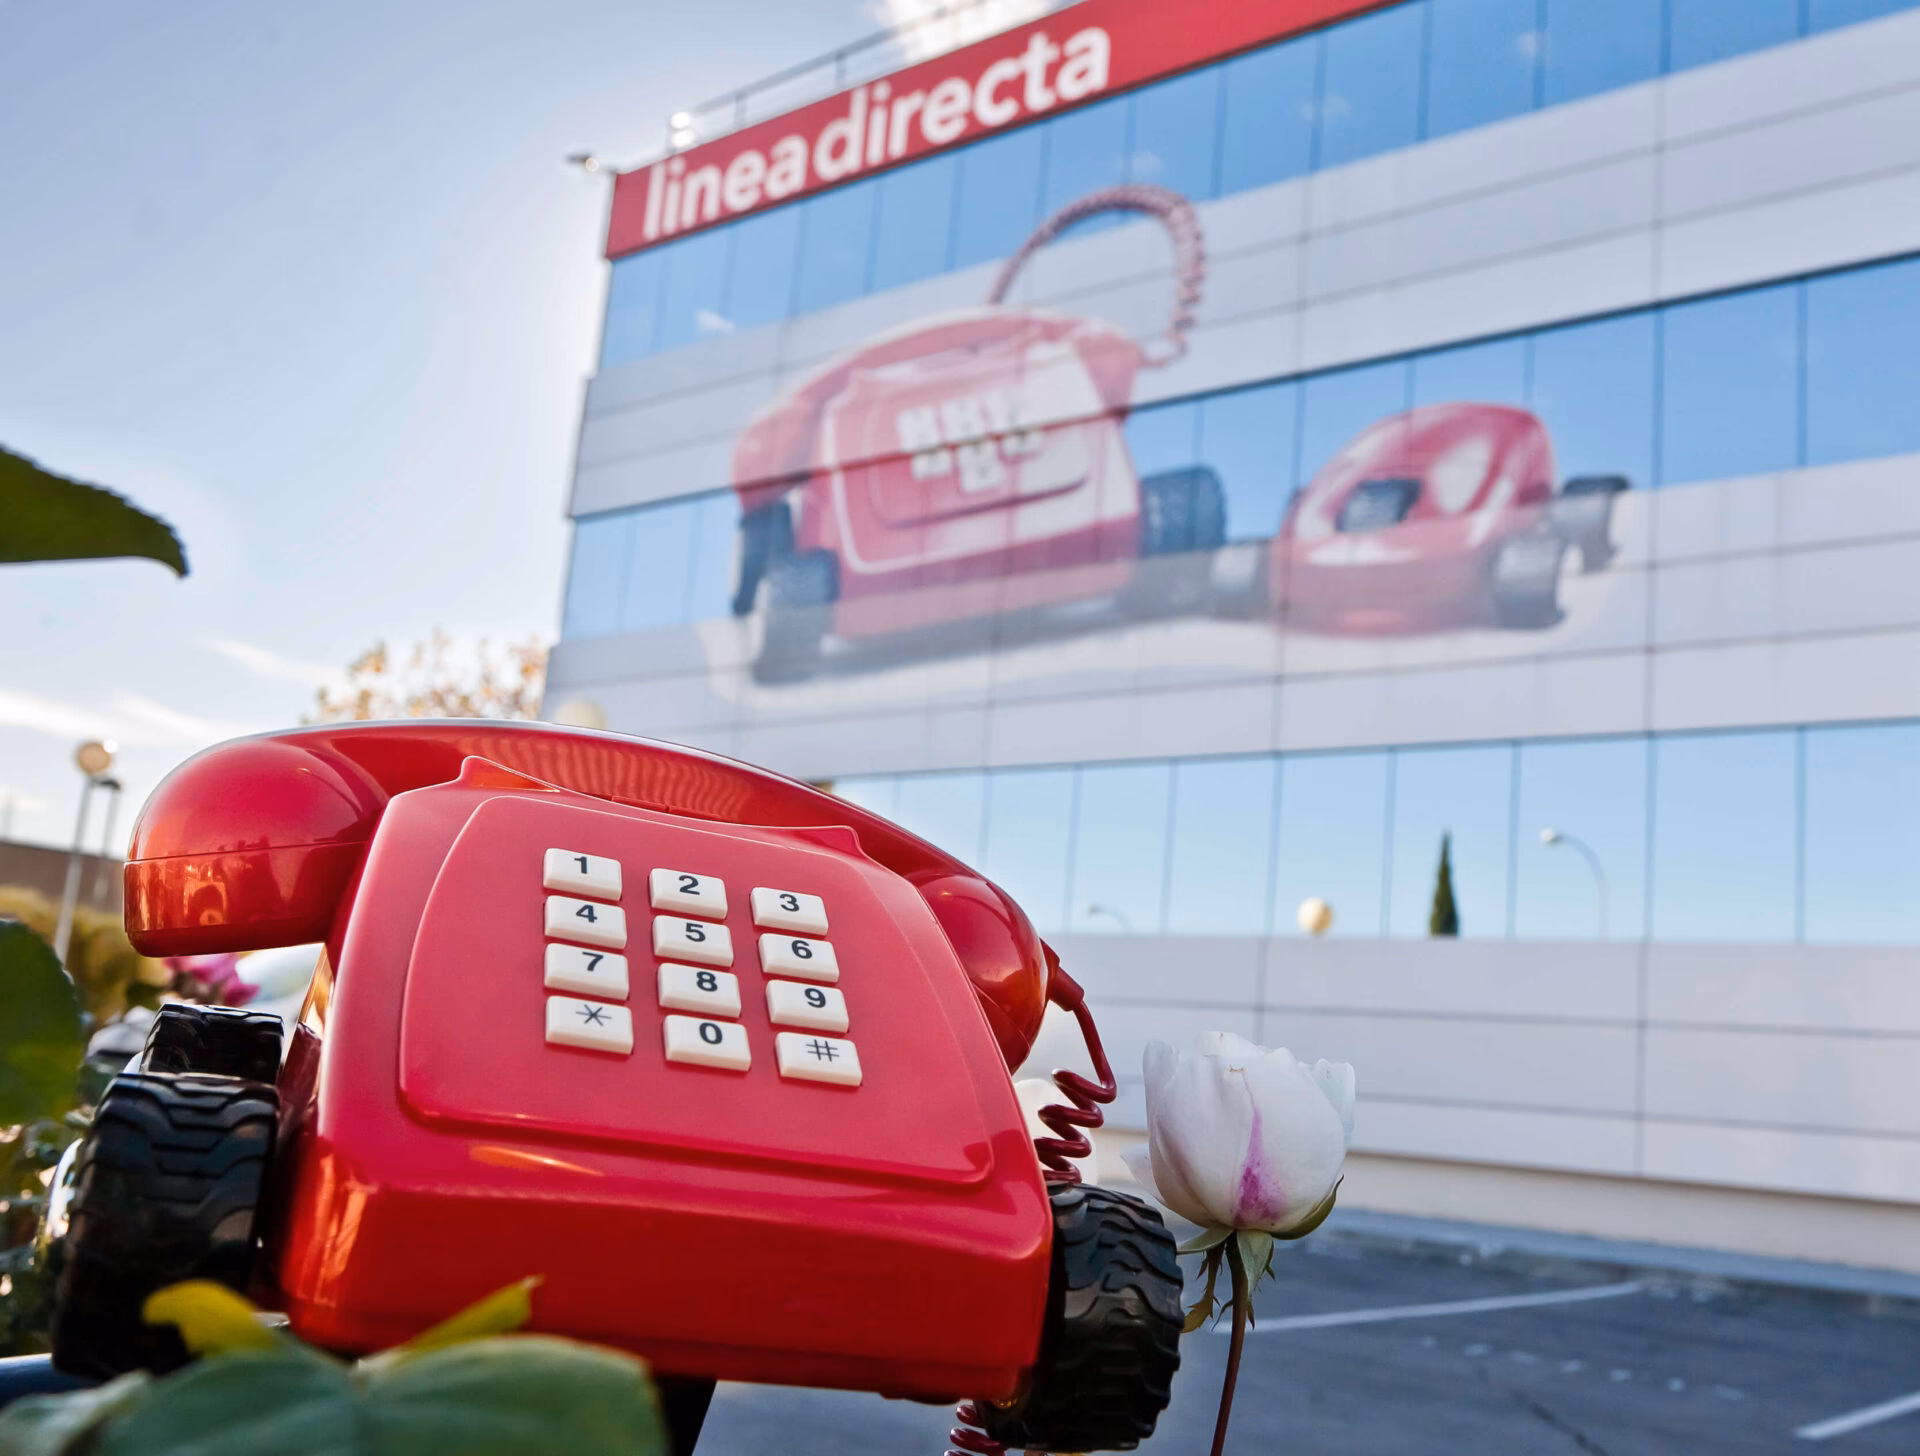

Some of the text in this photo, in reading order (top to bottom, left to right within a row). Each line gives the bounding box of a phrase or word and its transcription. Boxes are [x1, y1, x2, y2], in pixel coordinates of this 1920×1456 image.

[574, 856, 800, 912] 1 2 3
[576, 904, 812, 959] 4 5 6
[582, 951, 826, 1008] 7 8 9
[699, 1022, 723, 1045] 0
[805, 1039, 840, 1062] #
